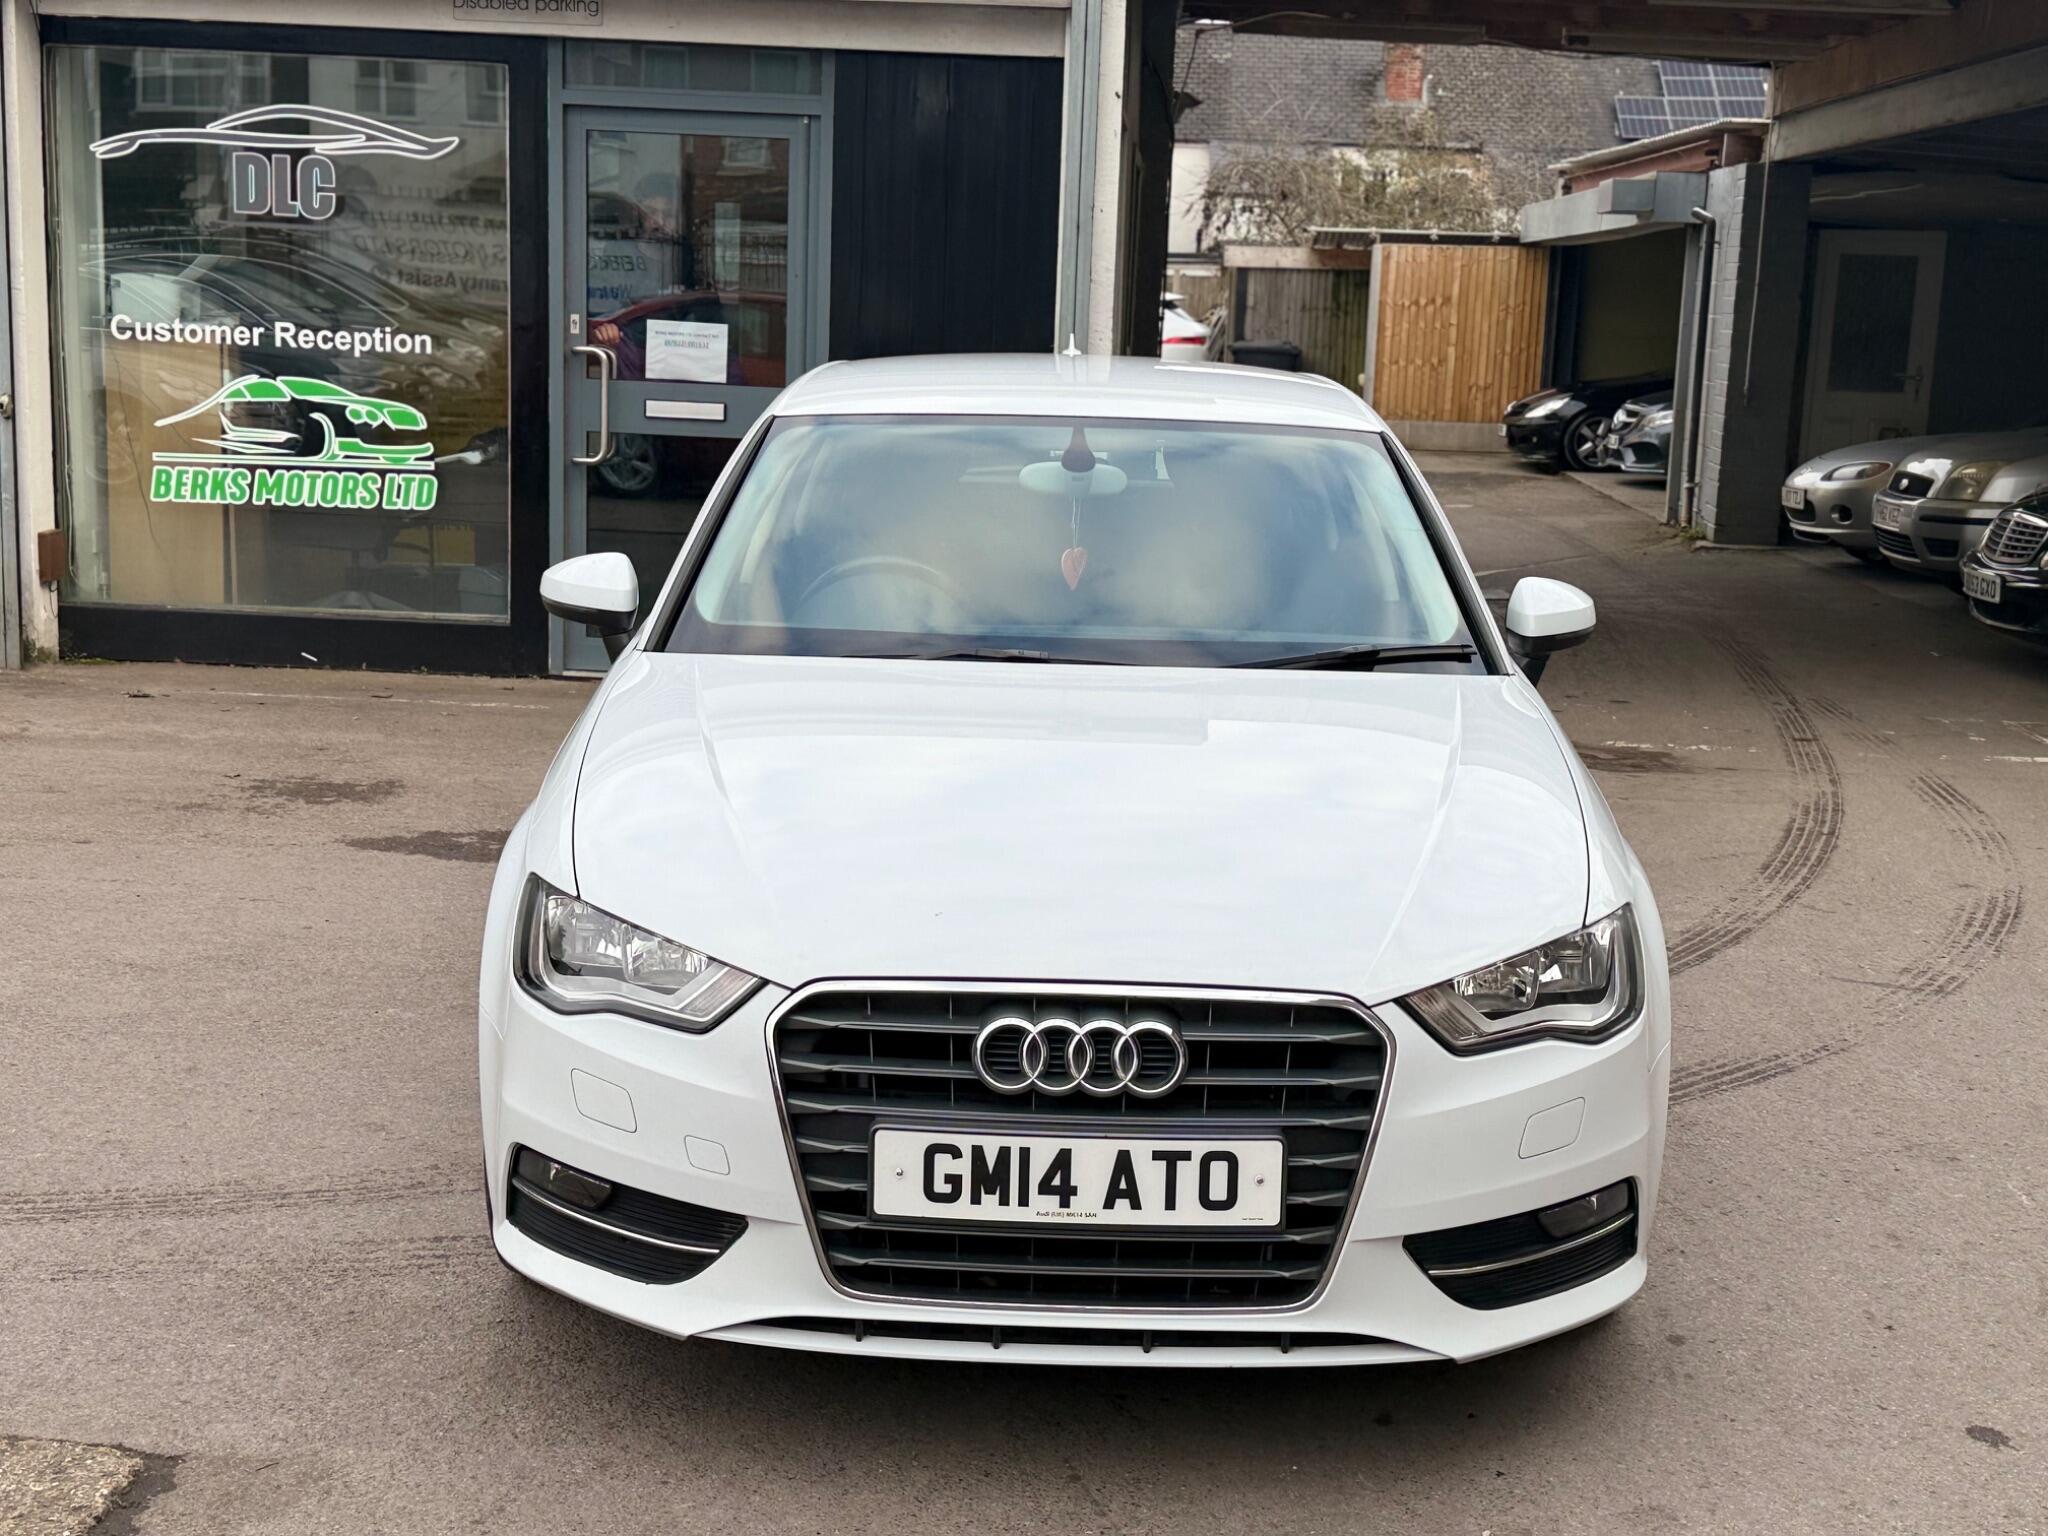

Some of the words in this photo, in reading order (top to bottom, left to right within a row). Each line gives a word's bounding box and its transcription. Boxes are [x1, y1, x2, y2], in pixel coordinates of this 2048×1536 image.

[453, 0, 528, 11] Disabled
[535, 0, 599, 16] parking
[232, 151, 336, 220] DLC
[110, 314, 265, 347] Customer
[274, 321, 433, 357] Reception
[150, 464, 250, 505] BERKS
[251, 468, 382, 509] MOTORS
[381, 472, 438, 511] LTD
[923, 1143, 1078, 1209] GM14
[1102, 1149, 1239, 1211] ATO
